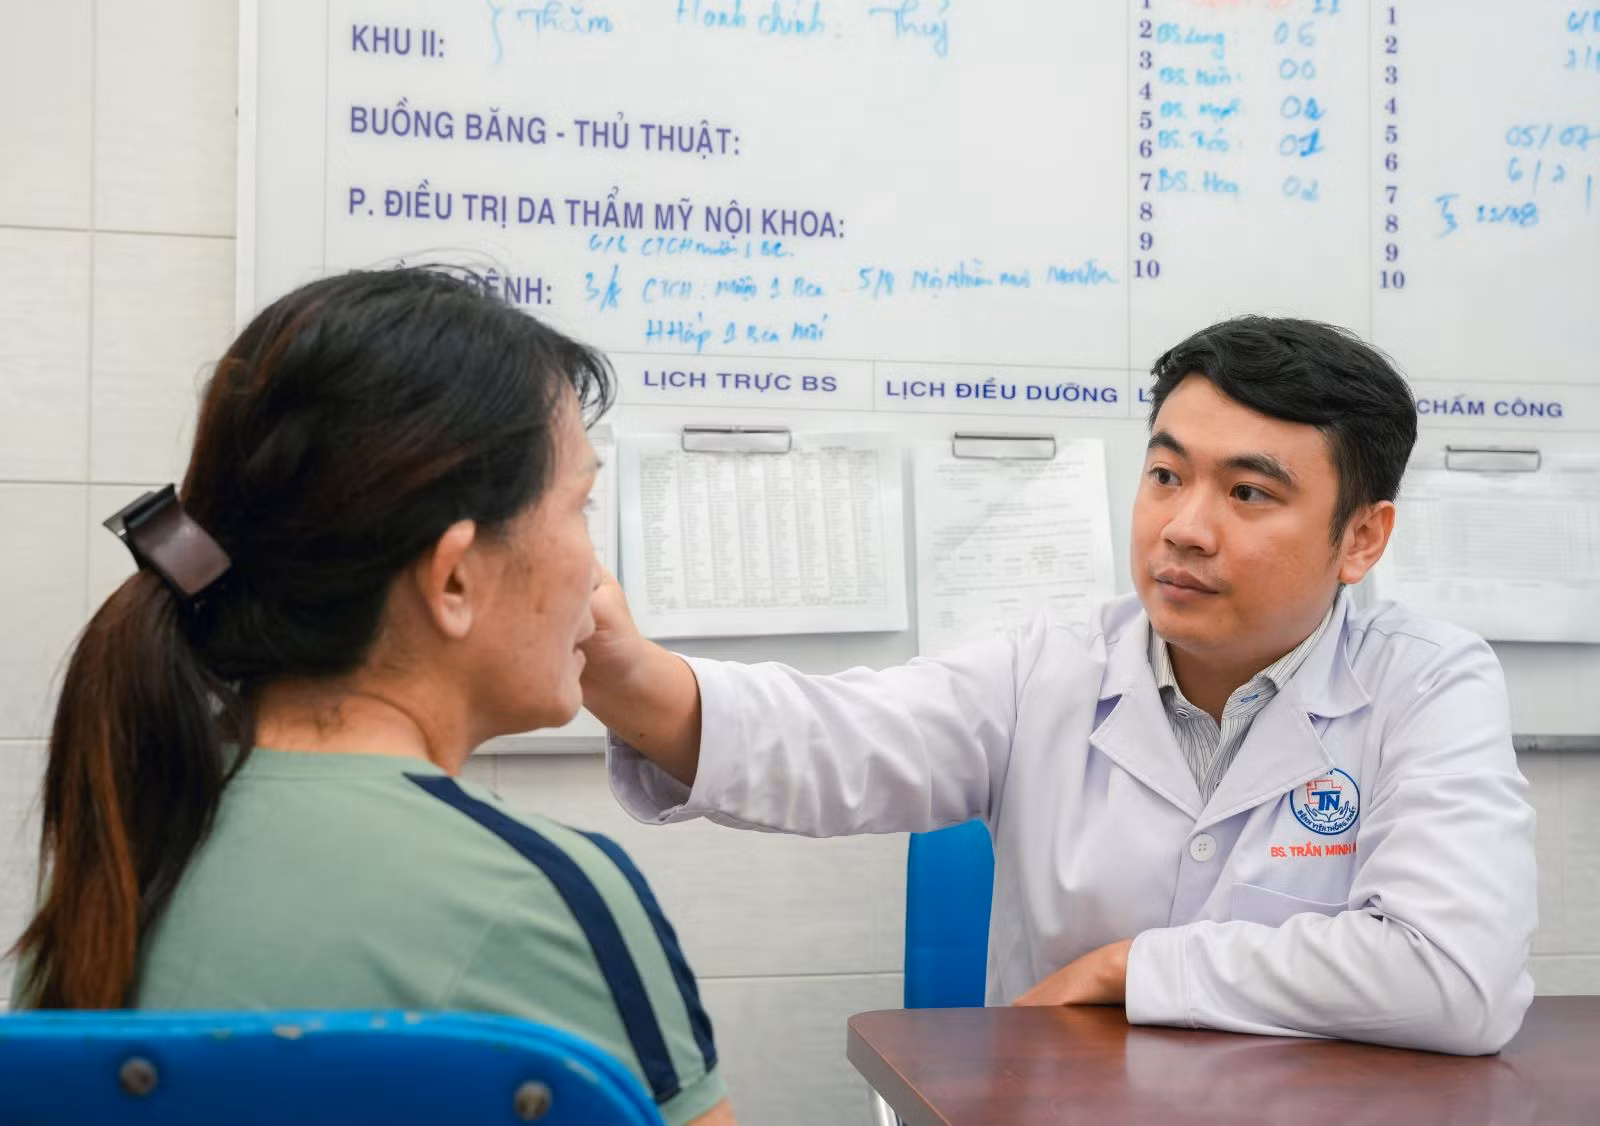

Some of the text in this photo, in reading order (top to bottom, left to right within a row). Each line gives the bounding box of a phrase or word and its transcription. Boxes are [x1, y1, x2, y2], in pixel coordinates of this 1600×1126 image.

[1388, 6, 1396, 25] 1
[1139, 20, 1153, 39] 2
[351, 24, 445, 58] KHU II:
[1385, 35, 1398, 54] 2
[1139, 50, 1153, 70] 3
[1385, 65, 1398, 85] 3
[1139, 81, 1153, 101] 4
[1385, 96, 1397, 115] 4
[350, 97, 454, 140] BUỒNG
[465, 107, 547, 145] BĂNG
[573, 111, 630, 150] THỦ
[639, 119, 740, 160] THUẬT:
[1139, 110, 1153, 130] 5
[1385, 123, 1398, 144] 5
[1139, 139, 1153, 159] 6
[1385, 152, 1398, 172] 6
[1139, 171, 1153, 192] 7
[1385, 184, 1398, 204] 7
[348, 179, 845, 240] P. ĐIỀU TRỊ DA THẨM MỸ NỘI KHOA:
[1139, 202, 1153, 222] 8
[1385, 214, 1399, 234] 8
[1139, 231, 1153, 251] 9
[1385, 242, 1399, 263] 9
[1135, 258, 1161, 279] 10
[1381, 270, 1405, 290] 10
[643, 370, 838, 393] LỊCH TRỰC BS
[886, 380, 946, 400] LỊCH
[955, 377, 1017, 401] ĐIỀU
[1026, 382, 1119, 404] DƯỠNG
[1417, 394, 1563, 418] CHẤM CÔNG
[1311, 789, 1341, 811] TN
[1270, 846, 1288, 858] BS.
[1289, 841, 1322, 857] TRẦN
[1325, 843, 1352, 856] MINH
